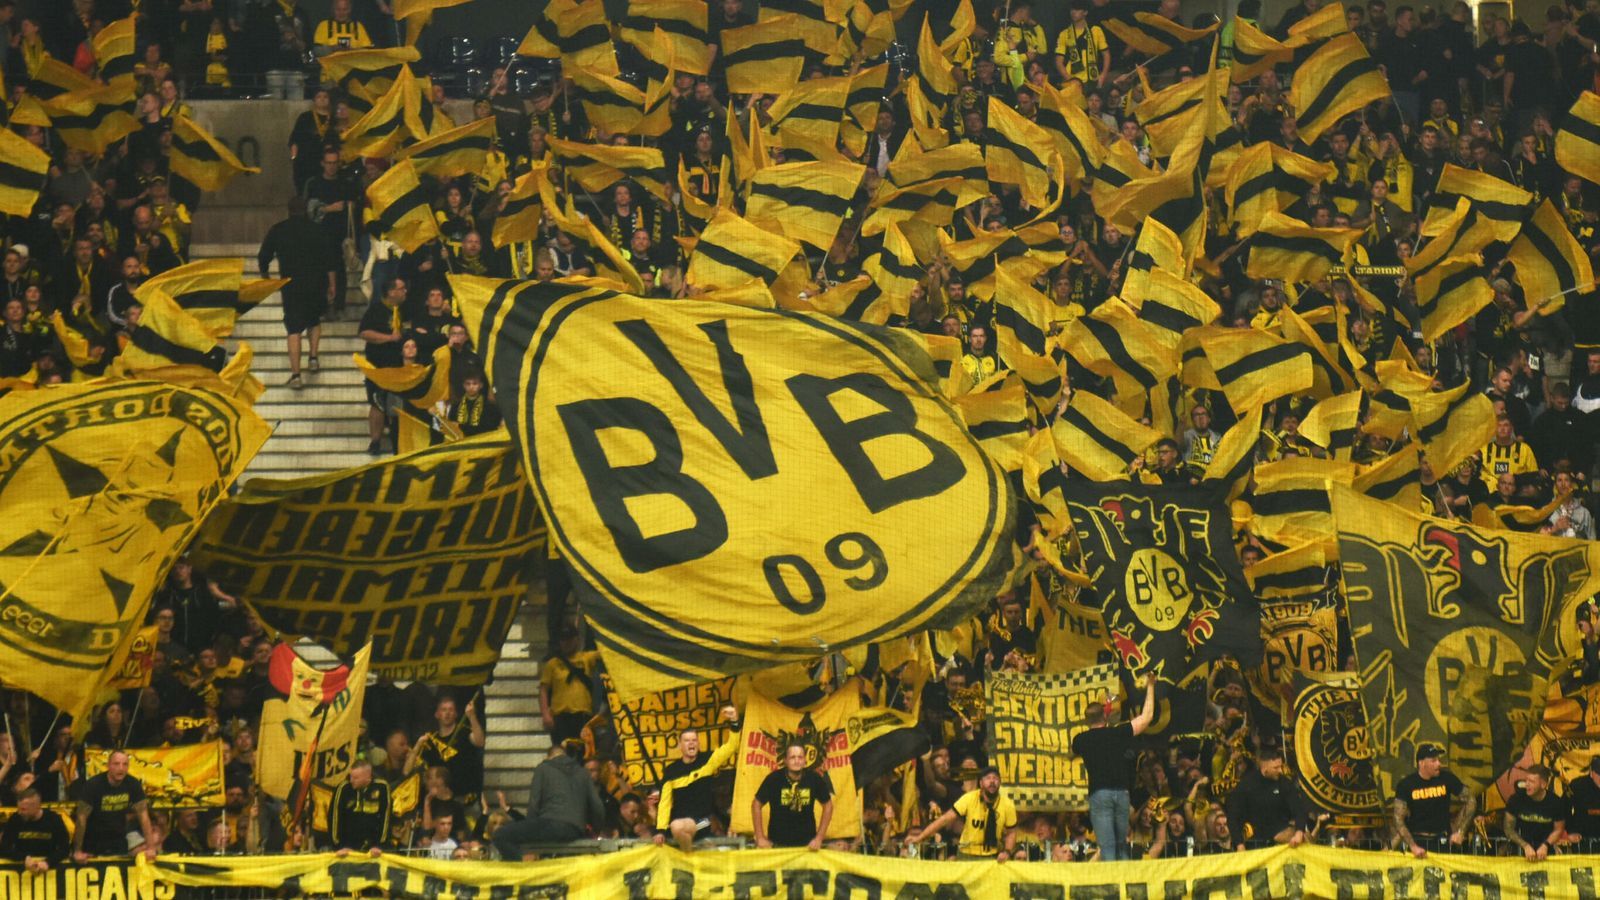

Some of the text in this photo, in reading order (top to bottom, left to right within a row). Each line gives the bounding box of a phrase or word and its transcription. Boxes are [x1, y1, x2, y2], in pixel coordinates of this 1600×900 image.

[558, 319, 966, 573] BVB
[763, 531, 889, 615] 09
[1133, 553, 1188, 605] BVB
[1057, 605, 1101, 639] THE
[1155, 606, 1174, 622] 09
[1301, 690, 1345, 719] THE
[1411, 784, 1447, 801] BURN
